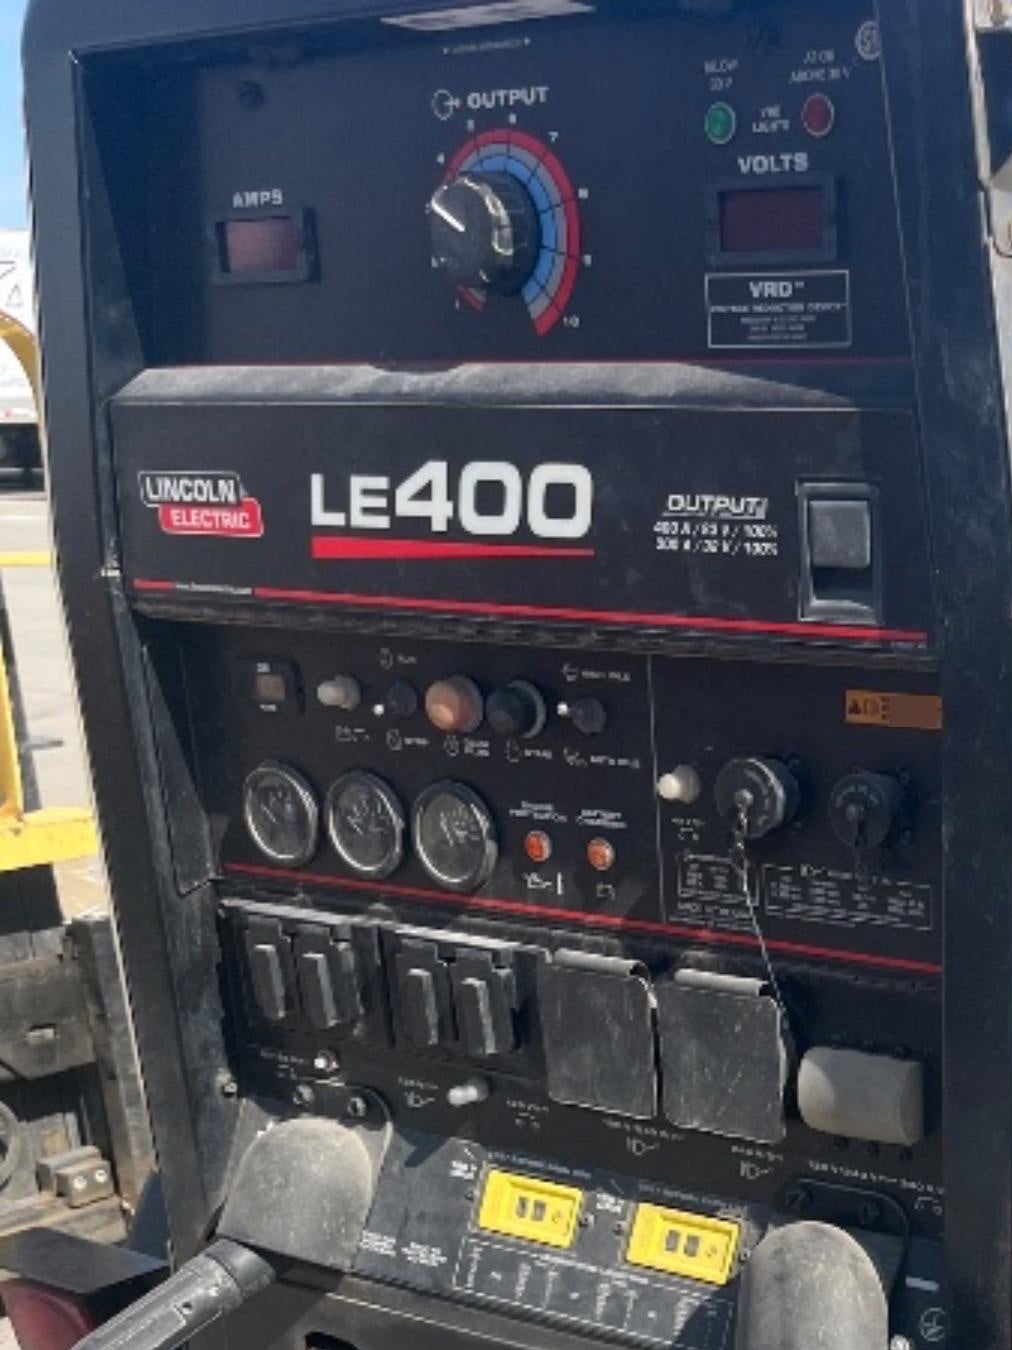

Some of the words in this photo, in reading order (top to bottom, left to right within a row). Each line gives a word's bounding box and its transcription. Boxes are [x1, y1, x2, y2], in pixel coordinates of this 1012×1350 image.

[467, 86, 549, 109] OUTPUT
[738, 152, 809, 175] VOLTS
[233, 189, 283, 208] AMPS
[145, 476, 236, 504] LINCOLN
[311, 459, 594, 538] LE400
[667, 493, 766, 516] OUTPUT
[170, 508, 251, 529] ELECTRIC
